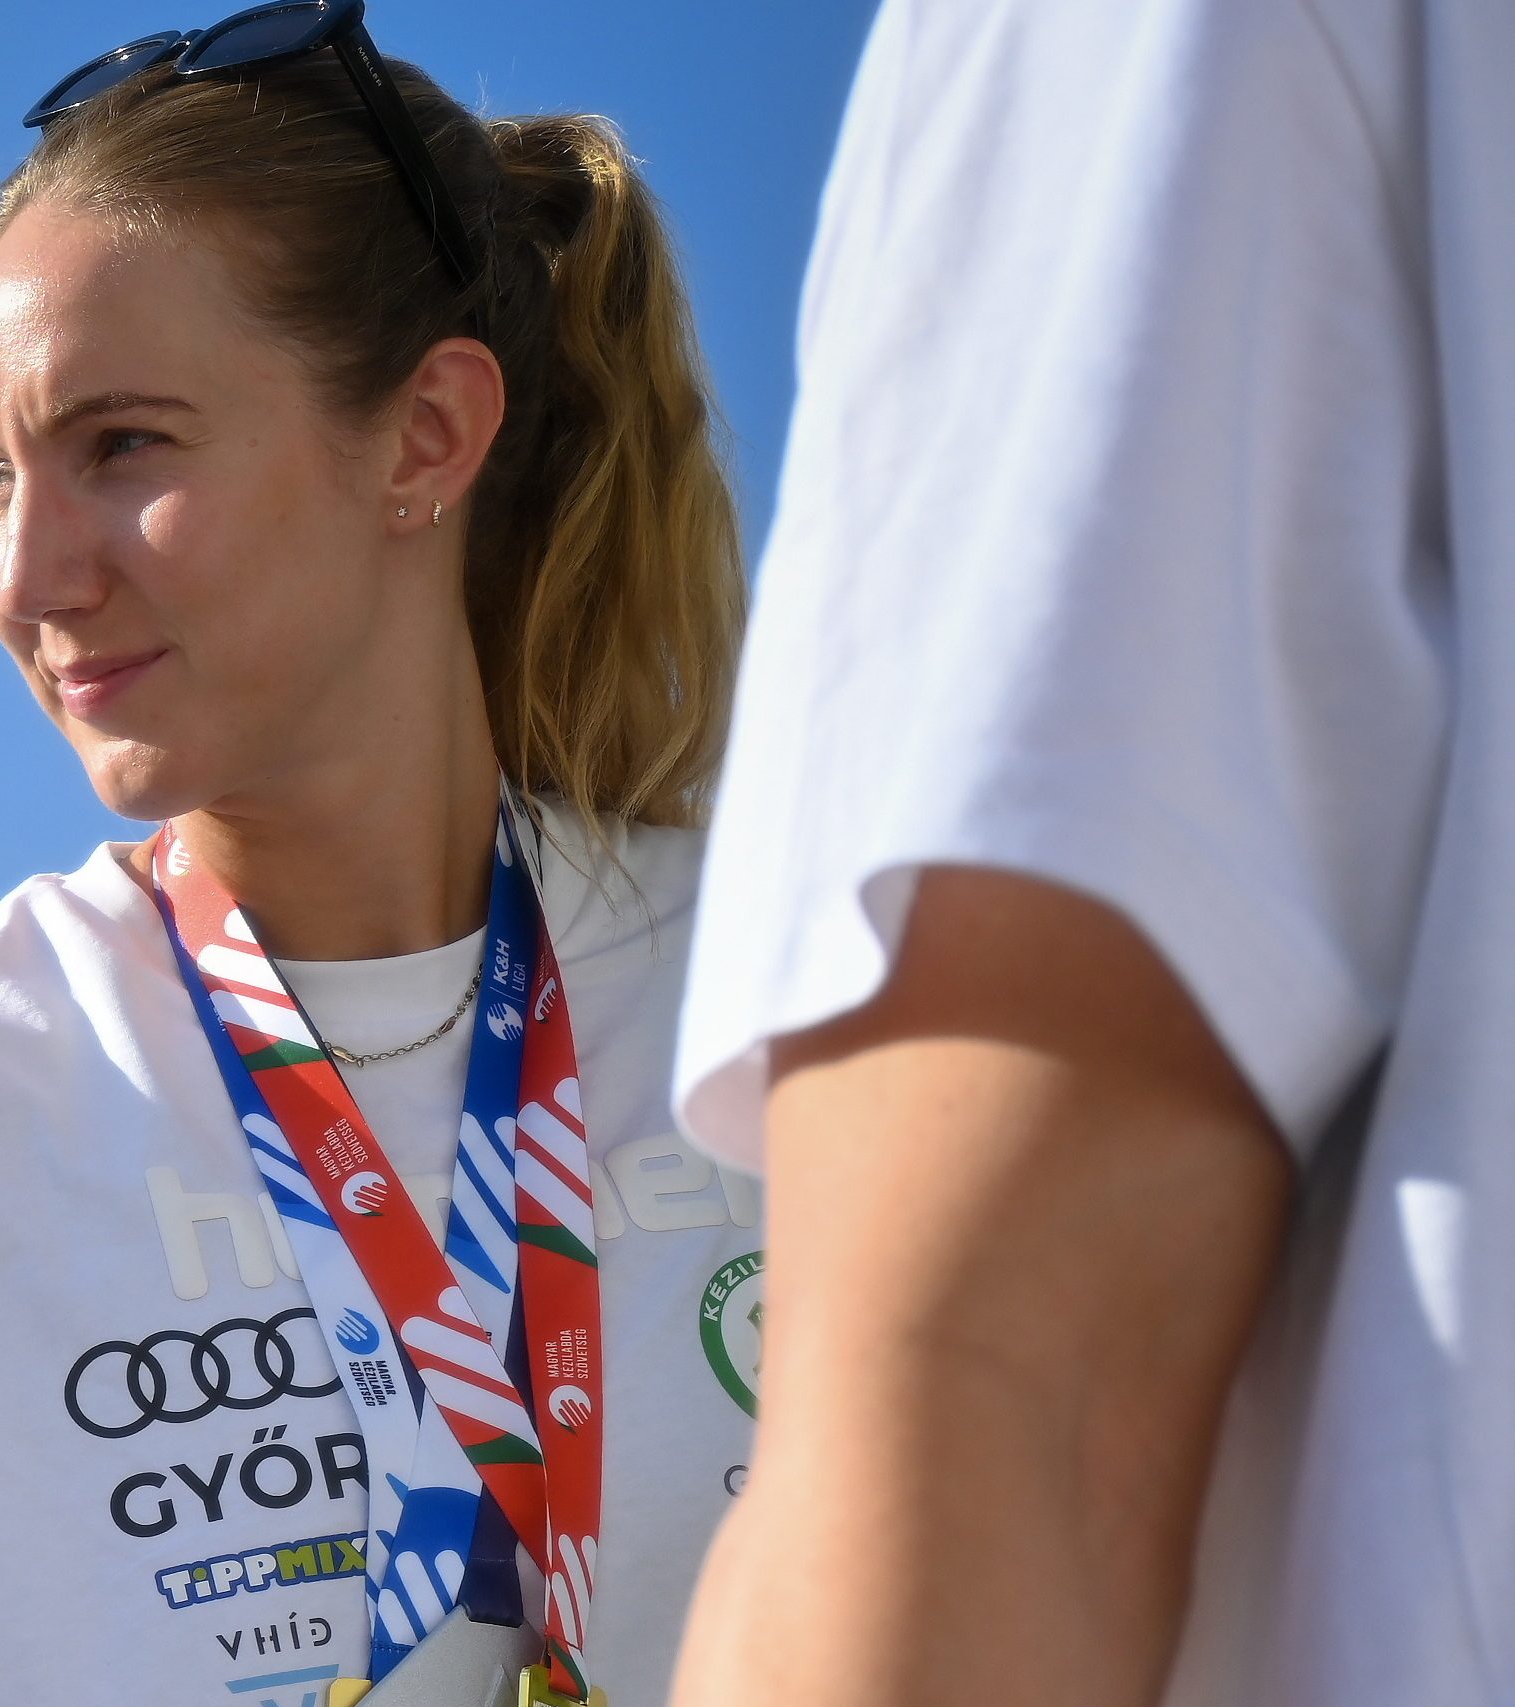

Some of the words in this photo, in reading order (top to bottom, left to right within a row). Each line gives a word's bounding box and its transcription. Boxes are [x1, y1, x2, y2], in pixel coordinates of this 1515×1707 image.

[493, 938, 510, 985] K&H
[511, 963, 526, 992] LIGA
[545, 1341, 560, 1378] MAGYAR
